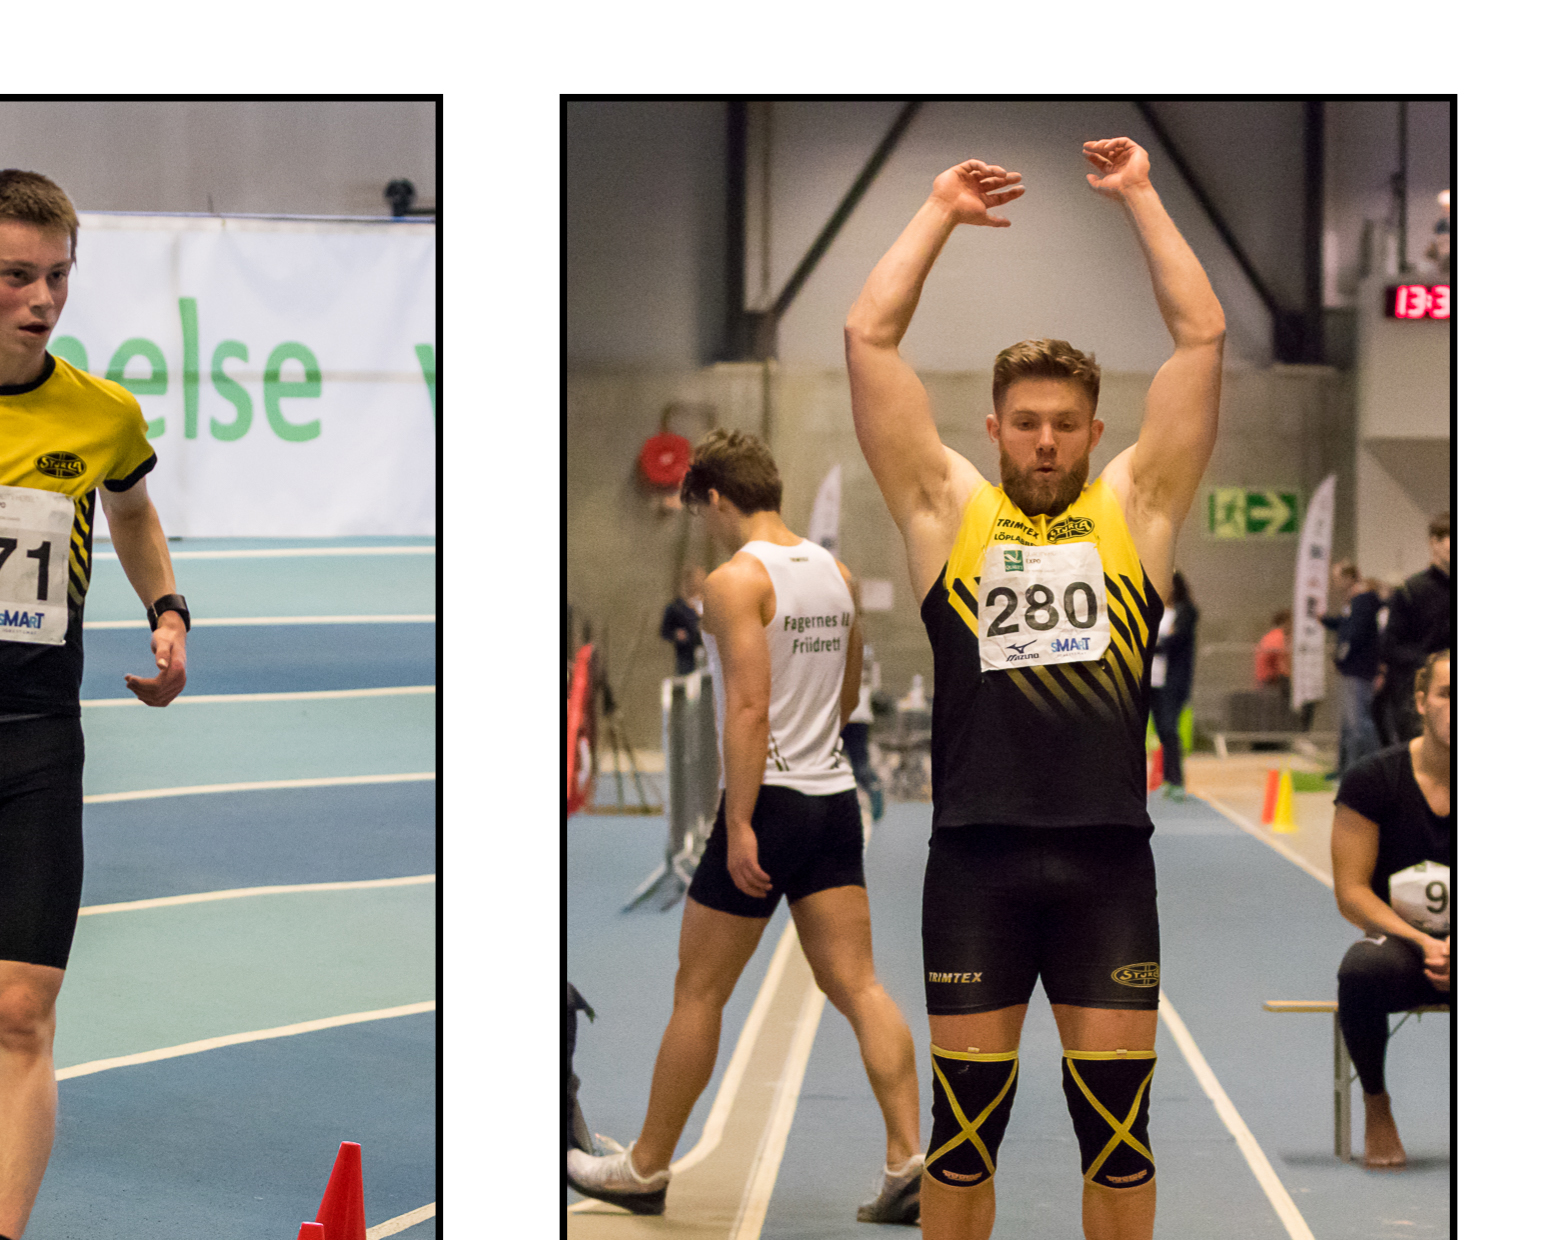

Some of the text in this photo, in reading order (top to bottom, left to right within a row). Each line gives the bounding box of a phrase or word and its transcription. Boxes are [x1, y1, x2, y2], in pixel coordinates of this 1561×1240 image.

[997, 518, 1040, 540] TRIMTEX
[985, 581, 1098, 638] 280
[784, 614, 838, 634] Fagernes
[1051, 637, 1091, 653] SMART
[928, 971, 983, 984] TRIMTEX
